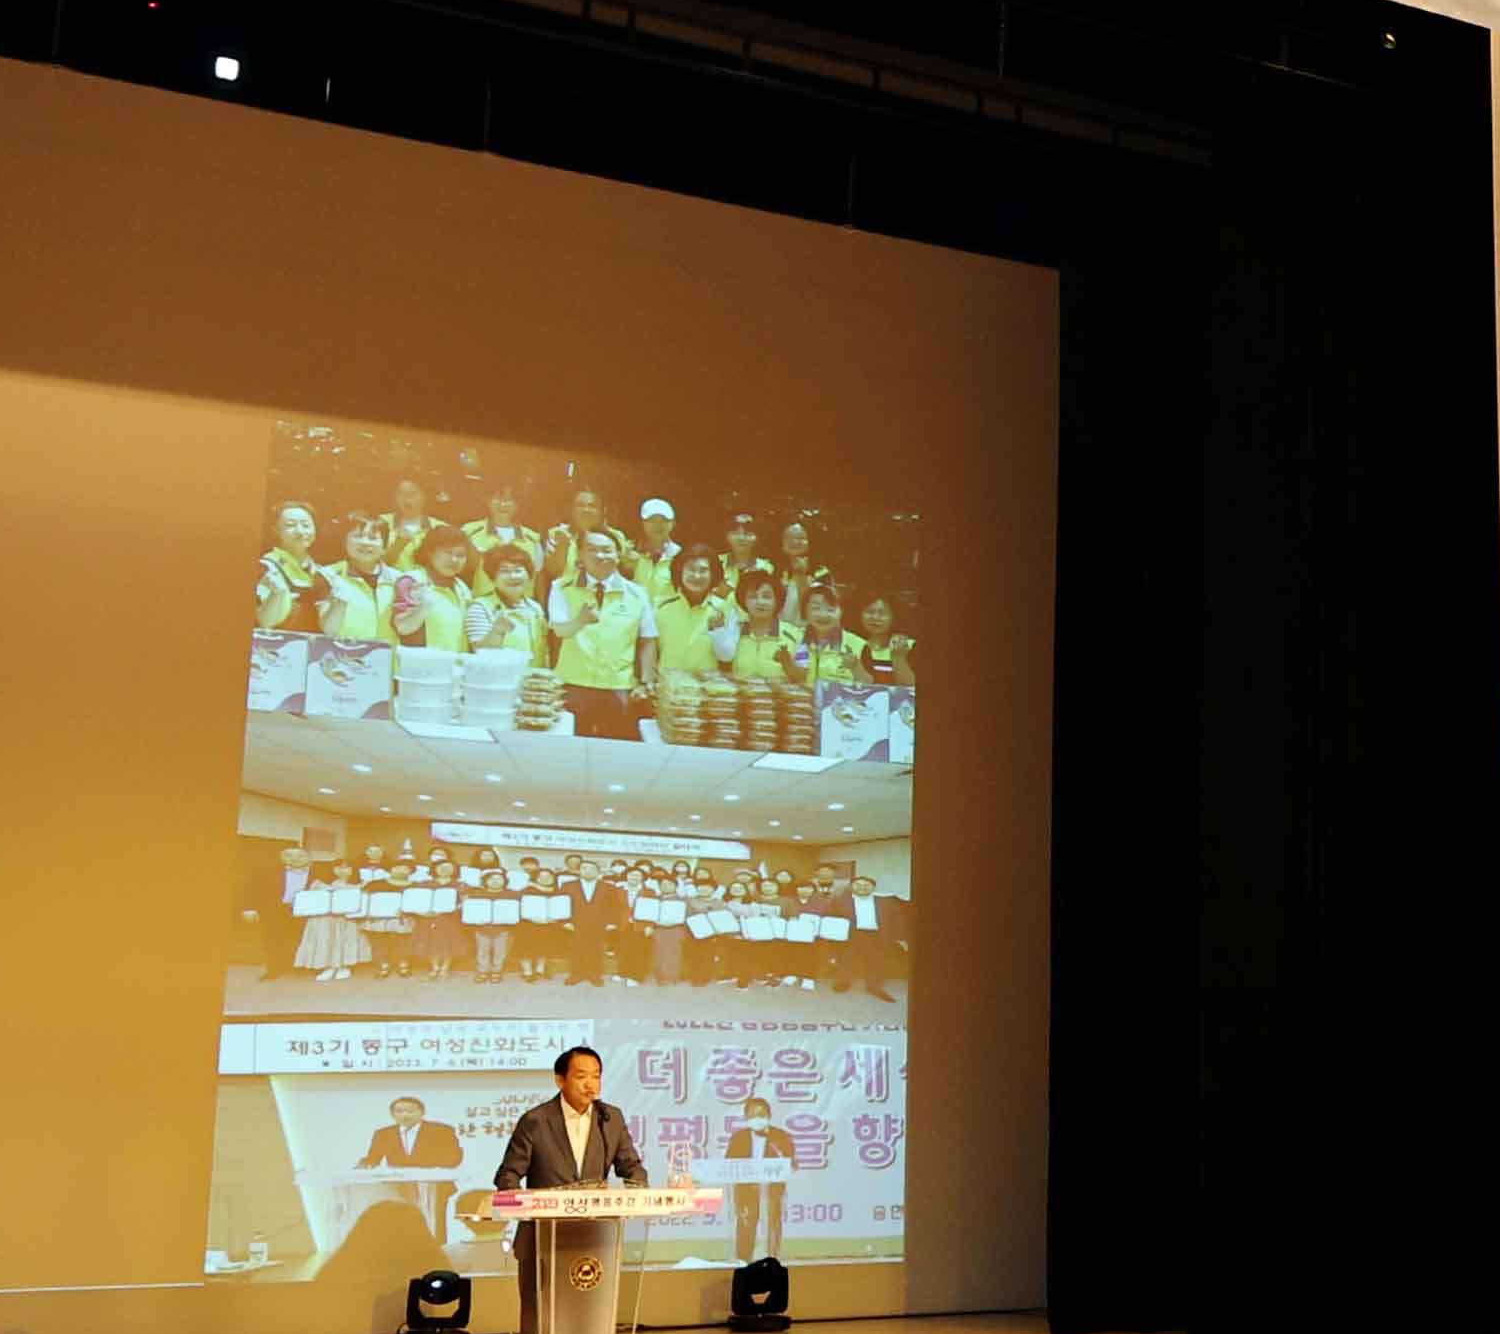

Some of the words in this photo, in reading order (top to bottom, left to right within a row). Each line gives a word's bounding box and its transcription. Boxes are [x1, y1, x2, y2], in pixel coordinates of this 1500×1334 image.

[287, 1039, 351, 1056] 제3기
[636, 1047, 688, 1105] 더
[705, 1046, 824, 1104] 좋은
[838, 1045, 906, 1104] 세
